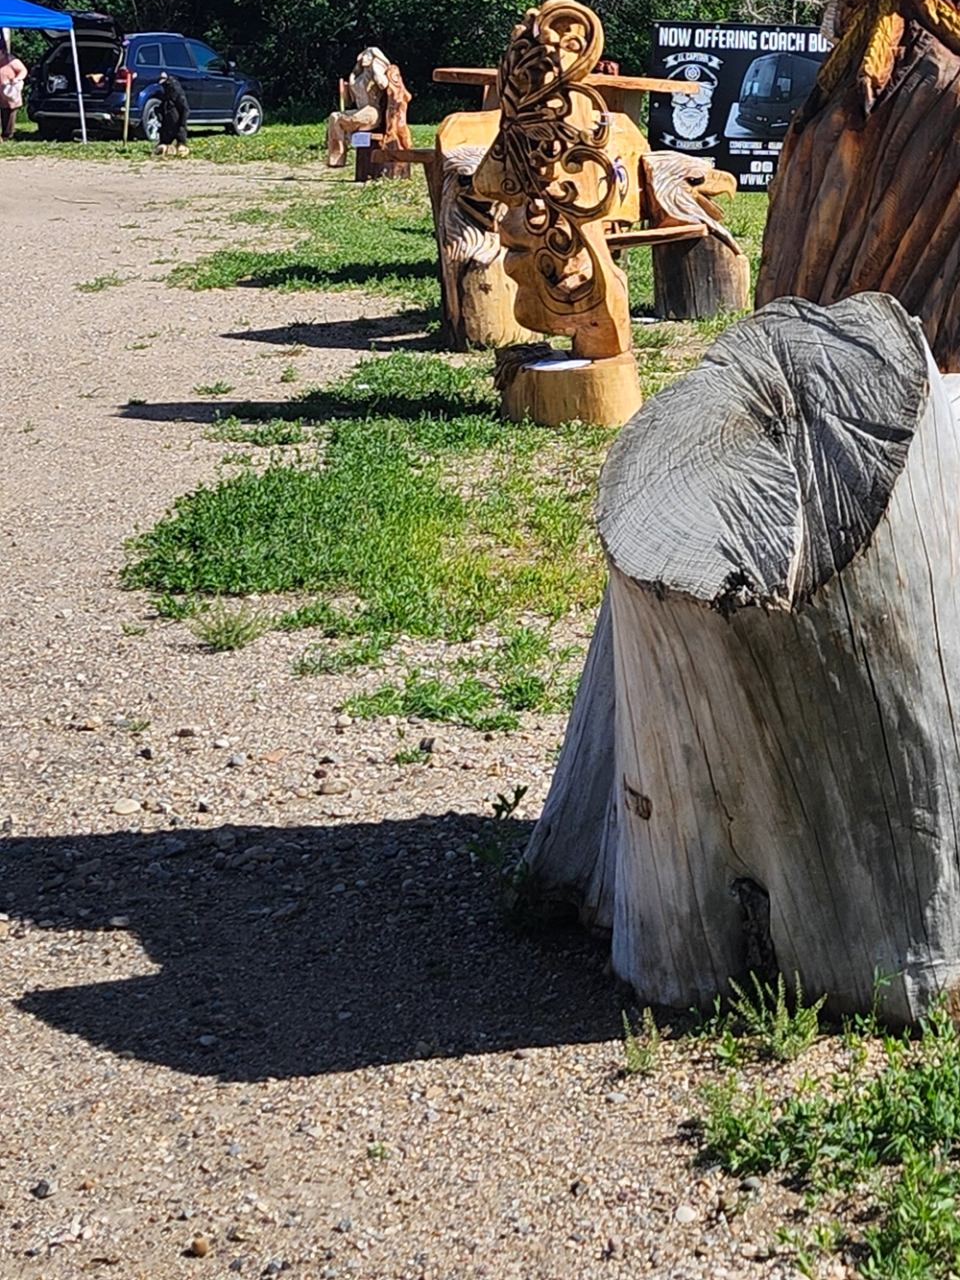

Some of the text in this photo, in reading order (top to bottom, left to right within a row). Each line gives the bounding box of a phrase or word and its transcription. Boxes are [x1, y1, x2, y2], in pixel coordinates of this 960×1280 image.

[659, 27, 692, 47] NOW
[694, 28, 758, 50] OFFERING
[760, 31, 806, 52] COACH
